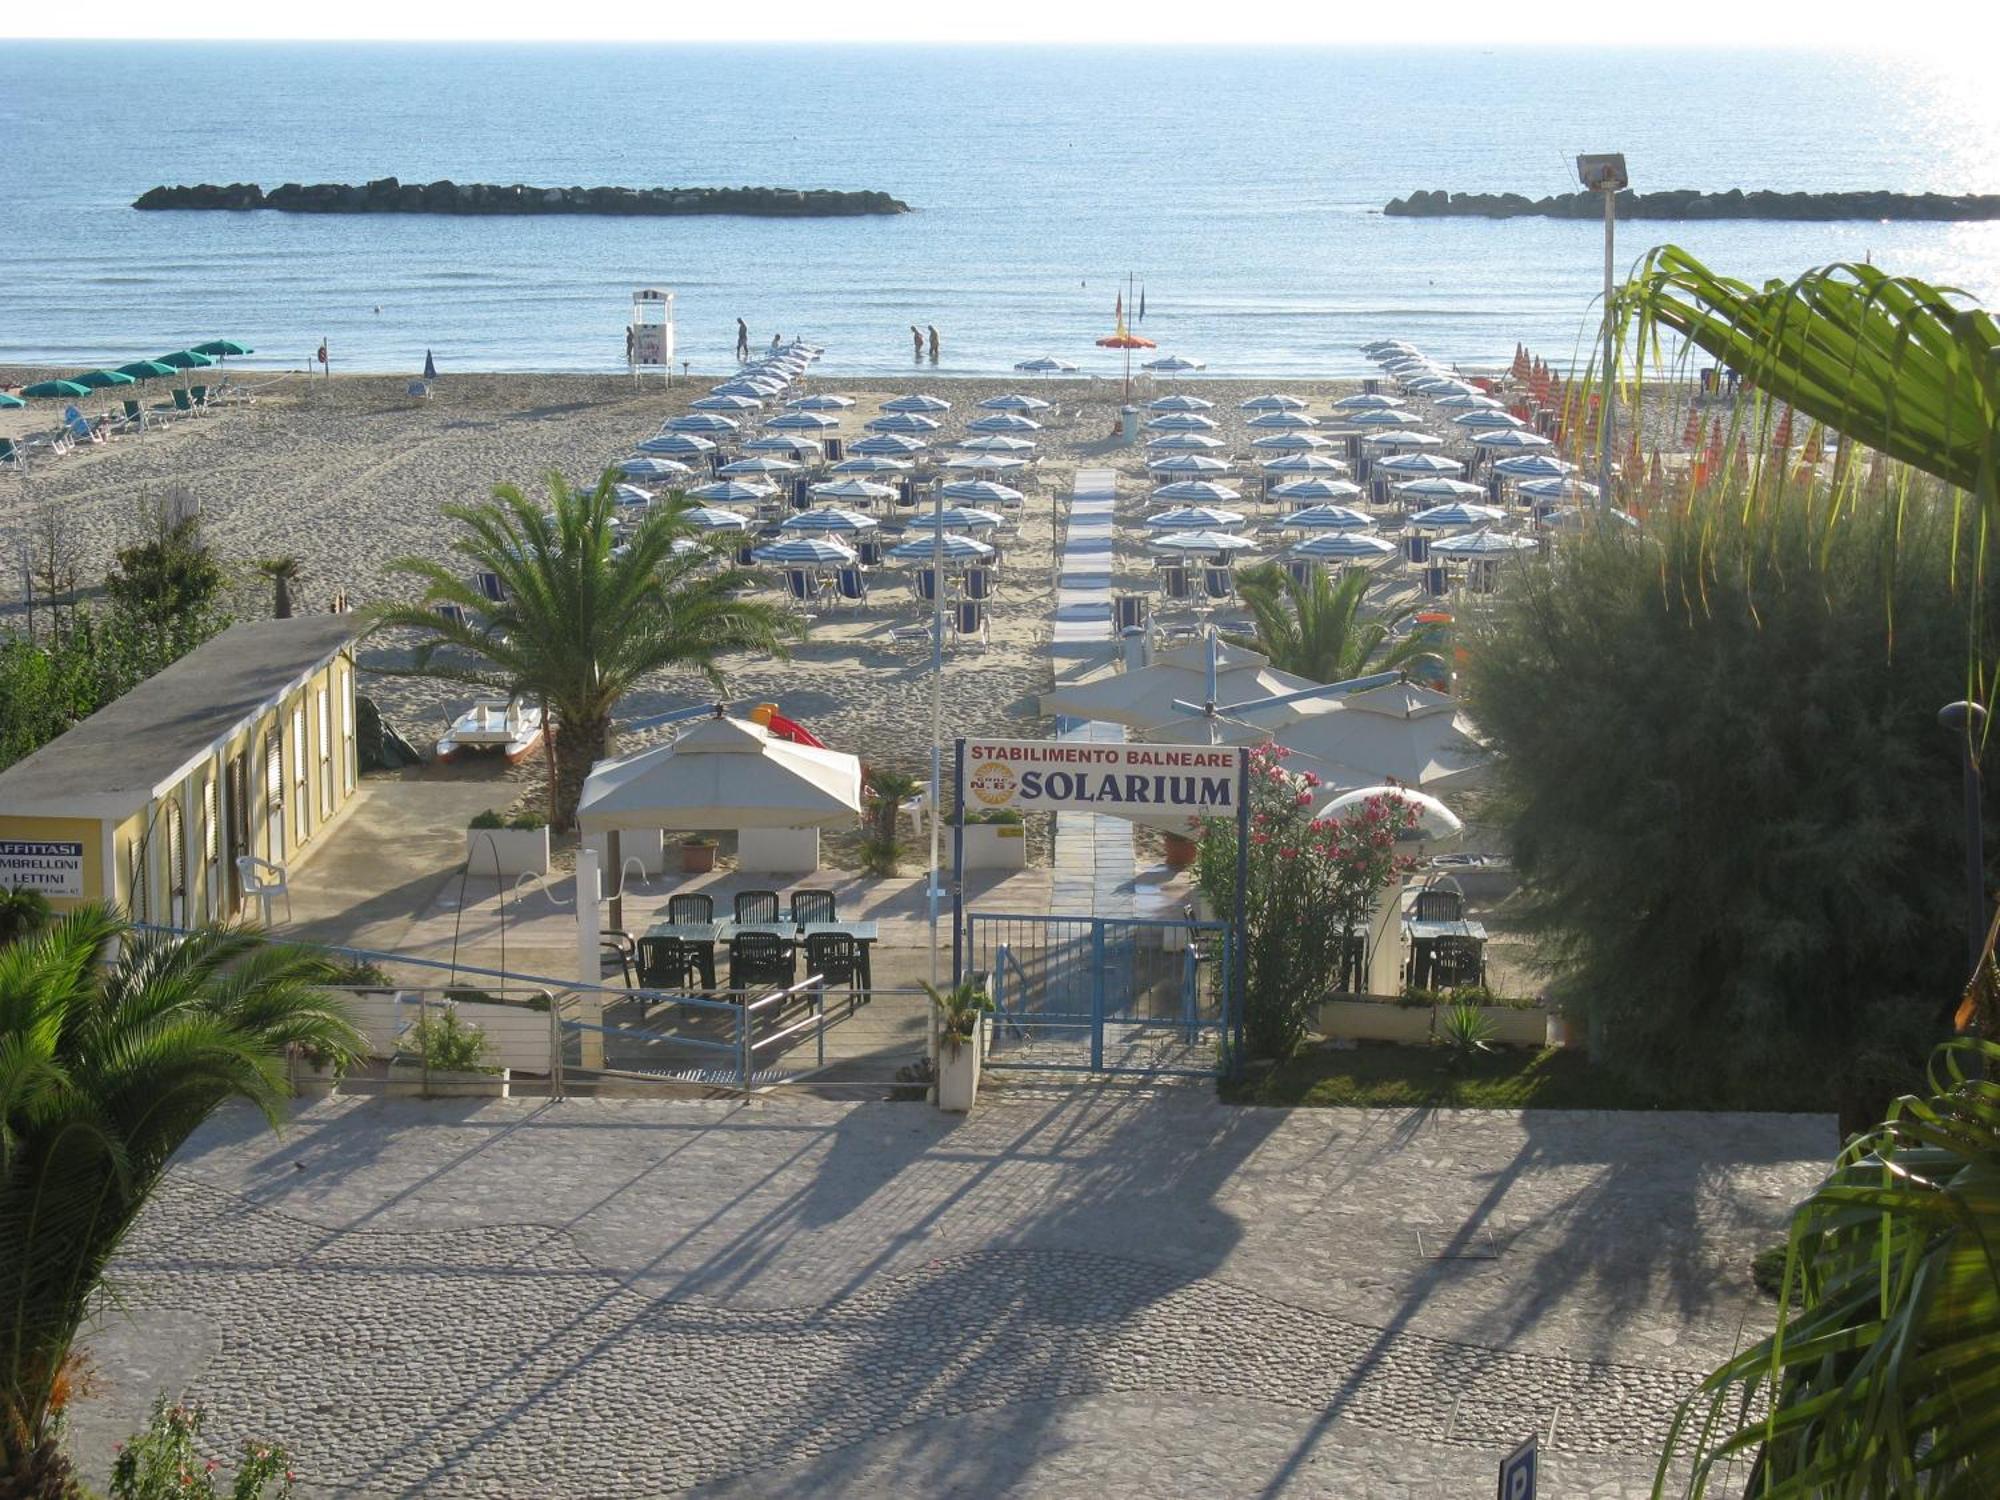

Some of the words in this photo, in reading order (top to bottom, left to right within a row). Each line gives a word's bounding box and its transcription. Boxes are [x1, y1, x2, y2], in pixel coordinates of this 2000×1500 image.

[971, 746, 1119, 764] STABILIMENTO
[1126, 751, 1233, 768] BALNEARE
[1019, 771, 1232, 806] SOLARIUM
[13, 873, 64, 884] LETTINI
